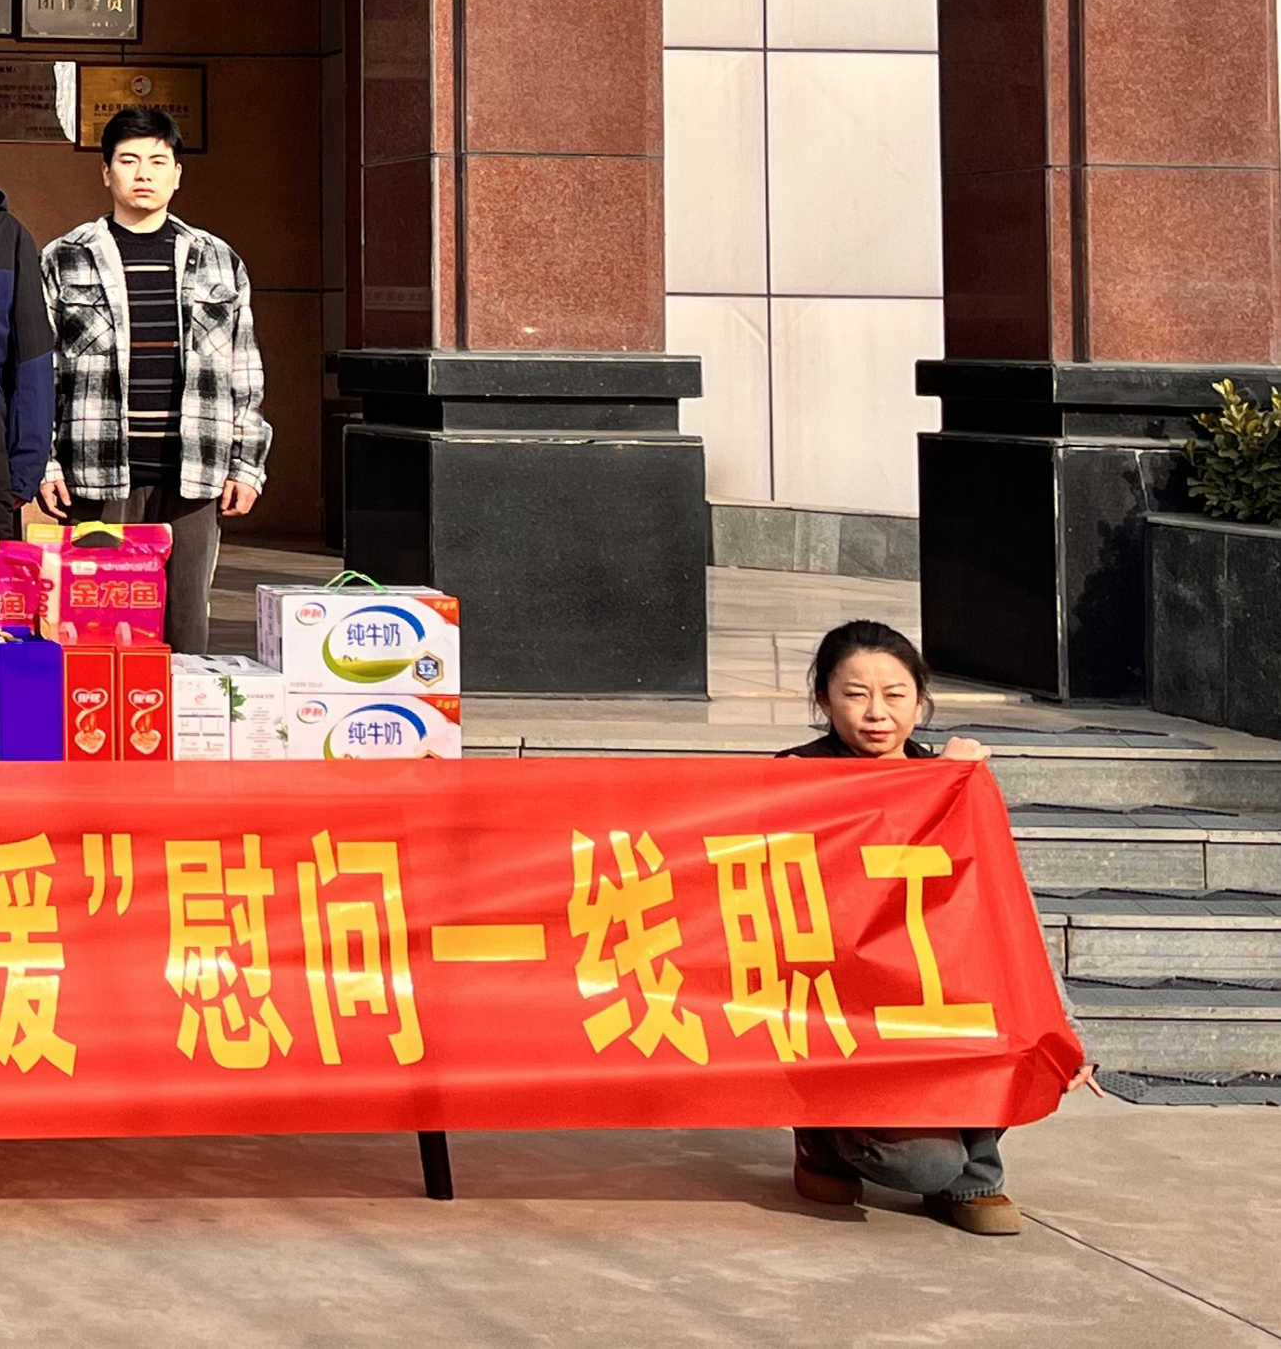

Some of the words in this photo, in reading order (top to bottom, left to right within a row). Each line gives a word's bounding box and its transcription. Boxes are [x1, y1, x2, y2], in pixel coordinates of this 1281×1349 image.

[70, 580, 162, 610] 金龙鱼
[346, 622, 401, 647] 纯牛奶
[348, 720, 403, 746] 纯牛奶
